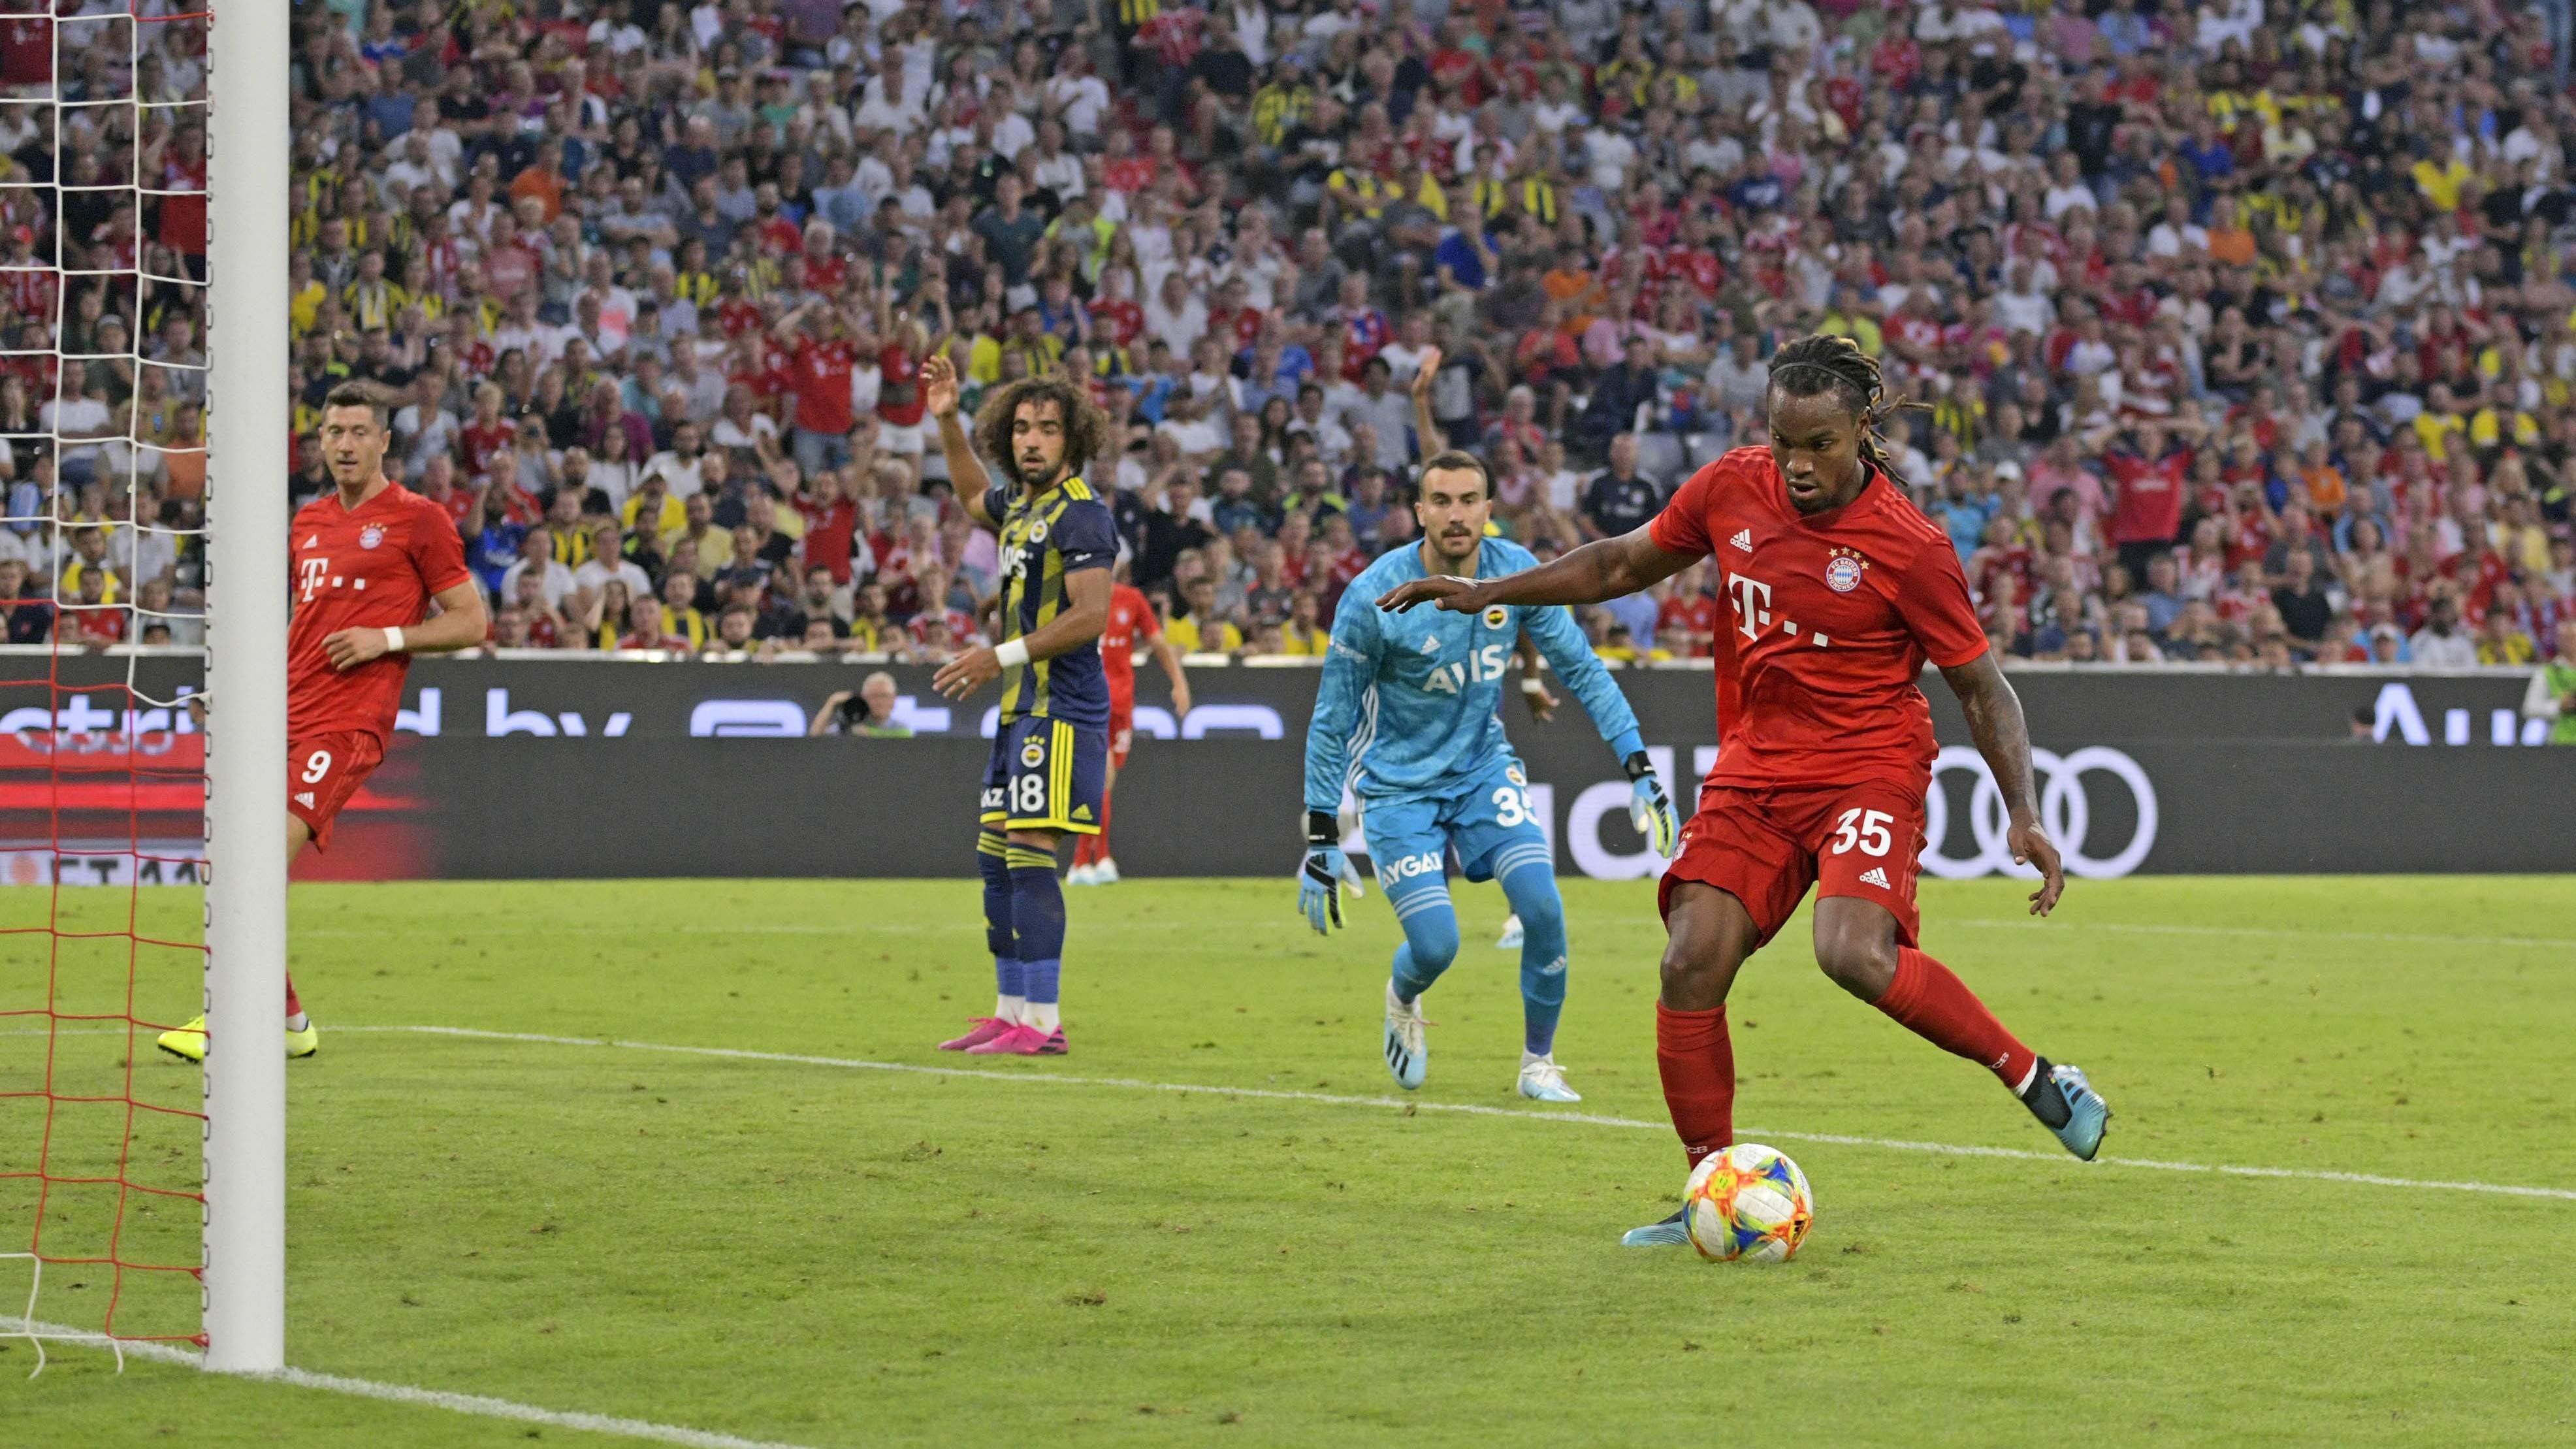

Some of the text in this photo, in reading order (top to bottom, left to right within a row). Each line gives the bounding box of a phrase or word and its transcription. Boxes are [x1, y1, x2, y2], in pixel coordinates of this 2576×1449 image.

[302, 750, 331, 784] 9
[1008, 773, 1044, 813] 18
[1832, 807, 1893, 856] 35
[1859, 874, 1891, 890] adidas
[1988, 1052, 2009, 1069] CB
